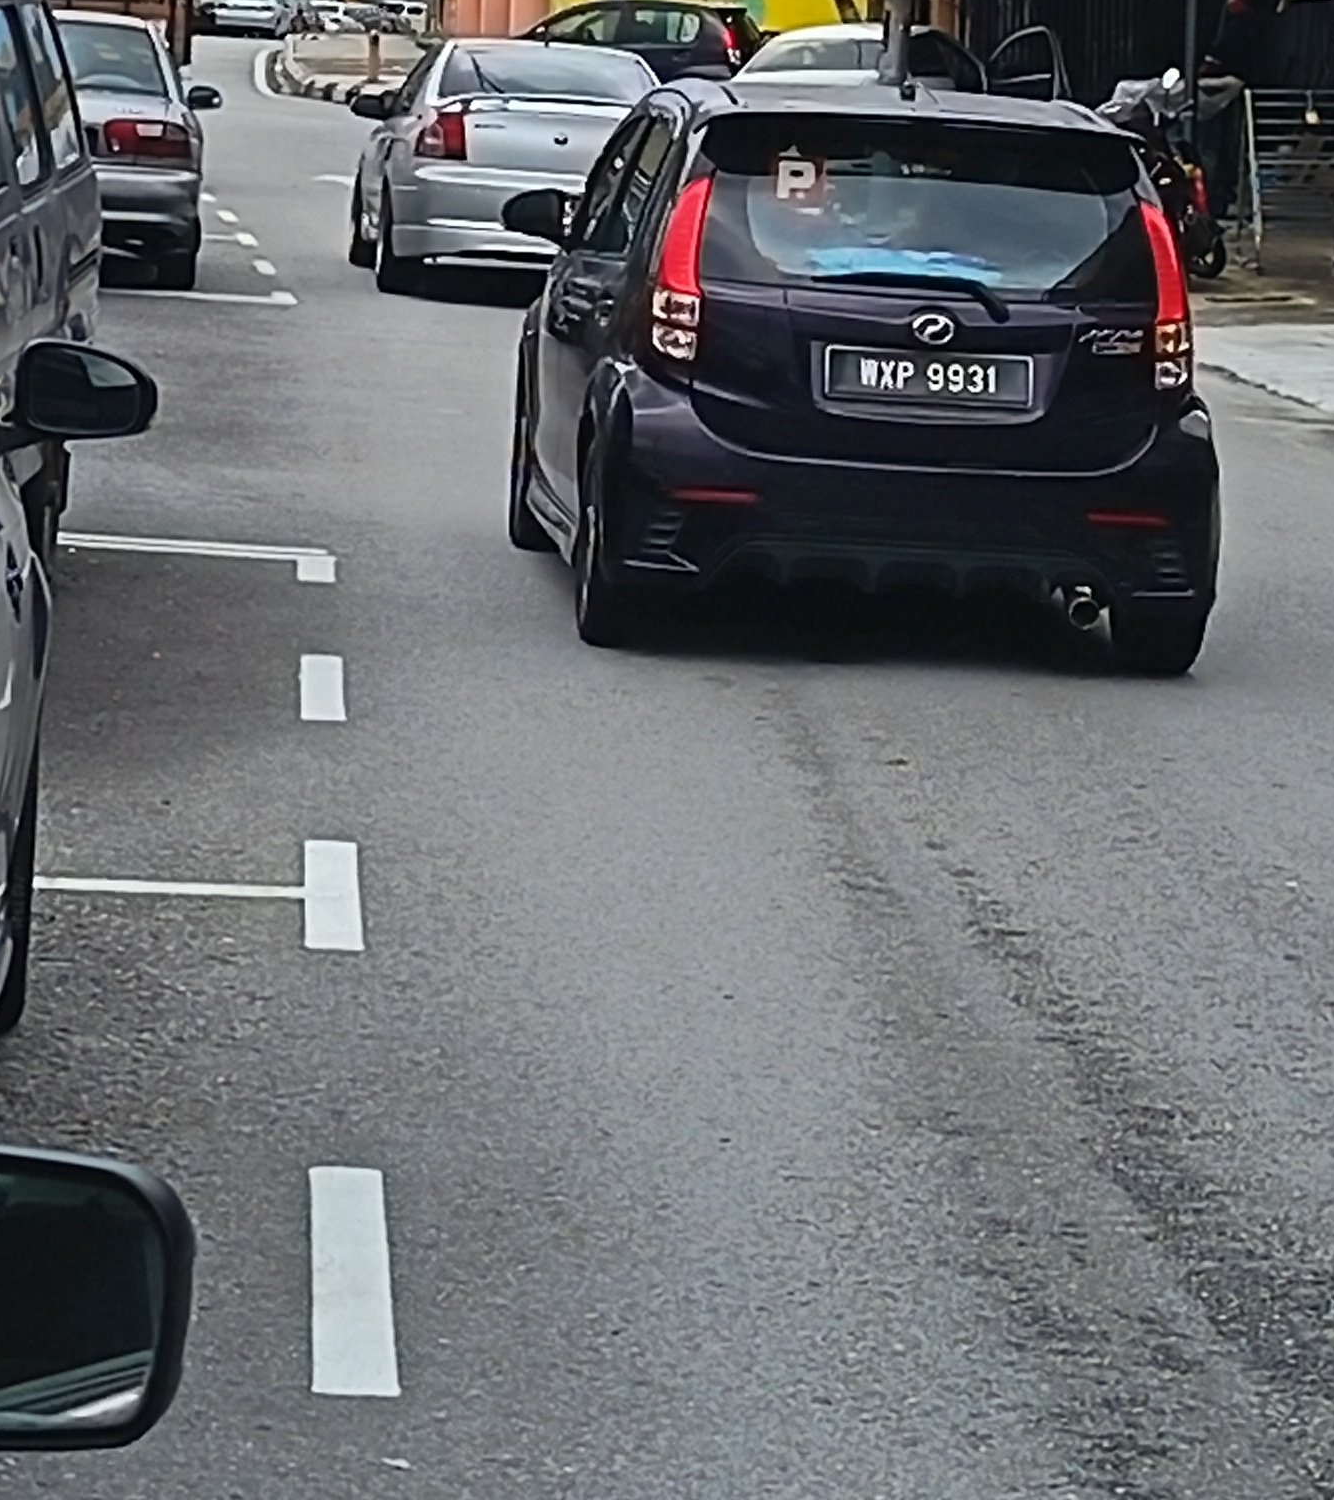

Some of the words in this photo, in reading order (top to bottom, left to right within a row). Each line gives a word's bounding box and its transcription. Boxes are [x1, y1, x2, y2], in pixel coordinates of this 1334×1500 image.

[776, 160, 816, 199] P
[860, 357, 915, 390] WXP
[926, 362, 997, 394] 9931
